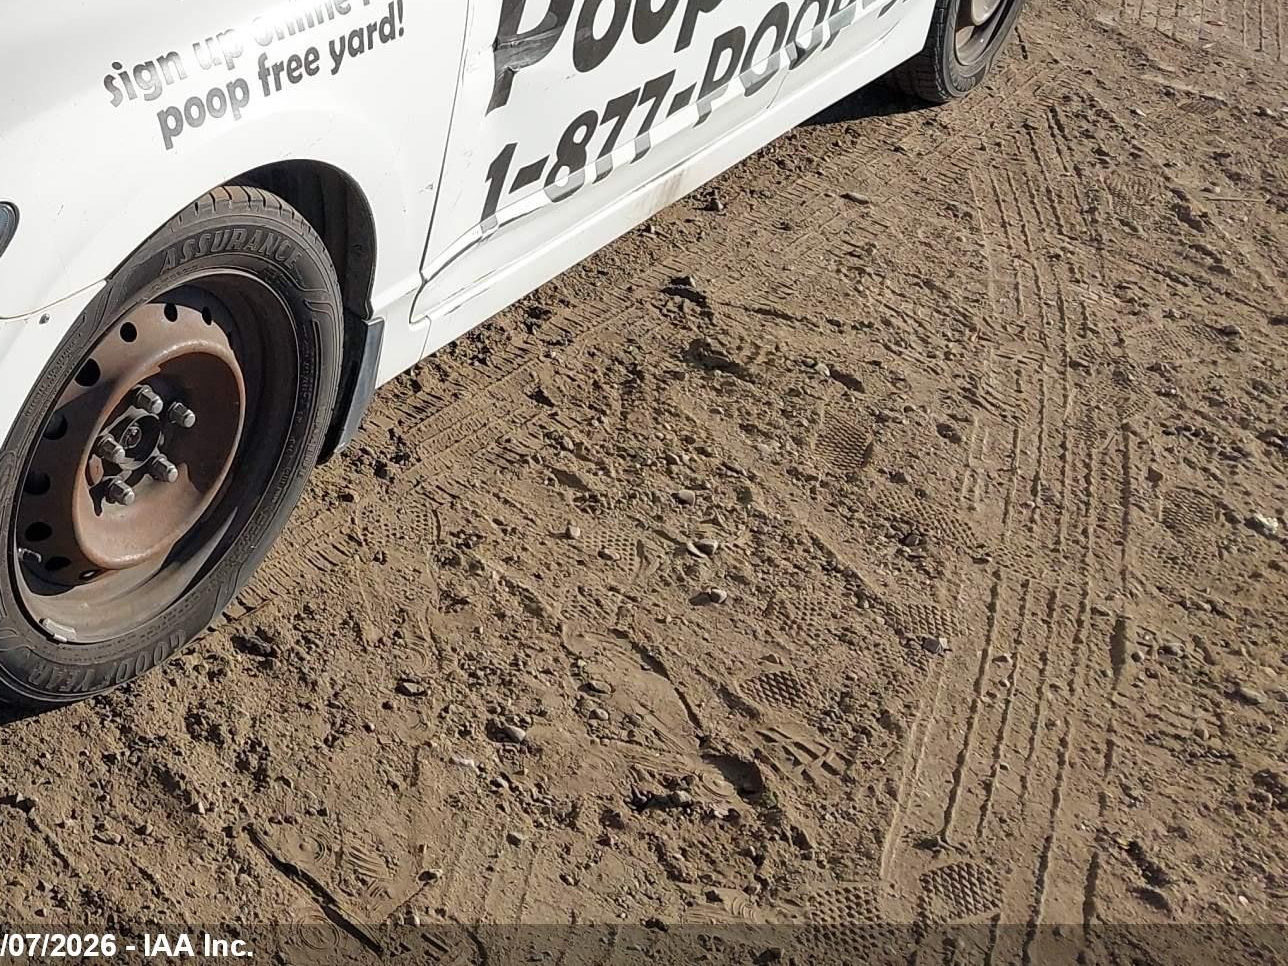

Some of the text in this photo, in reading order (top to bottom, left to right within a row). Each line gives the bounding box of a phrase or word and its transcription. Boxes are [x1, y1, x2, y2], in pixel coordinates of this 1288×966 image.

[103, 51, 188, 108] sign
[192, 28, 244, 71] up
[156, 77, 251, 151] poop
[257, 51, 321, 98] free
[160, 228, 304, 275] ASSURANCE
